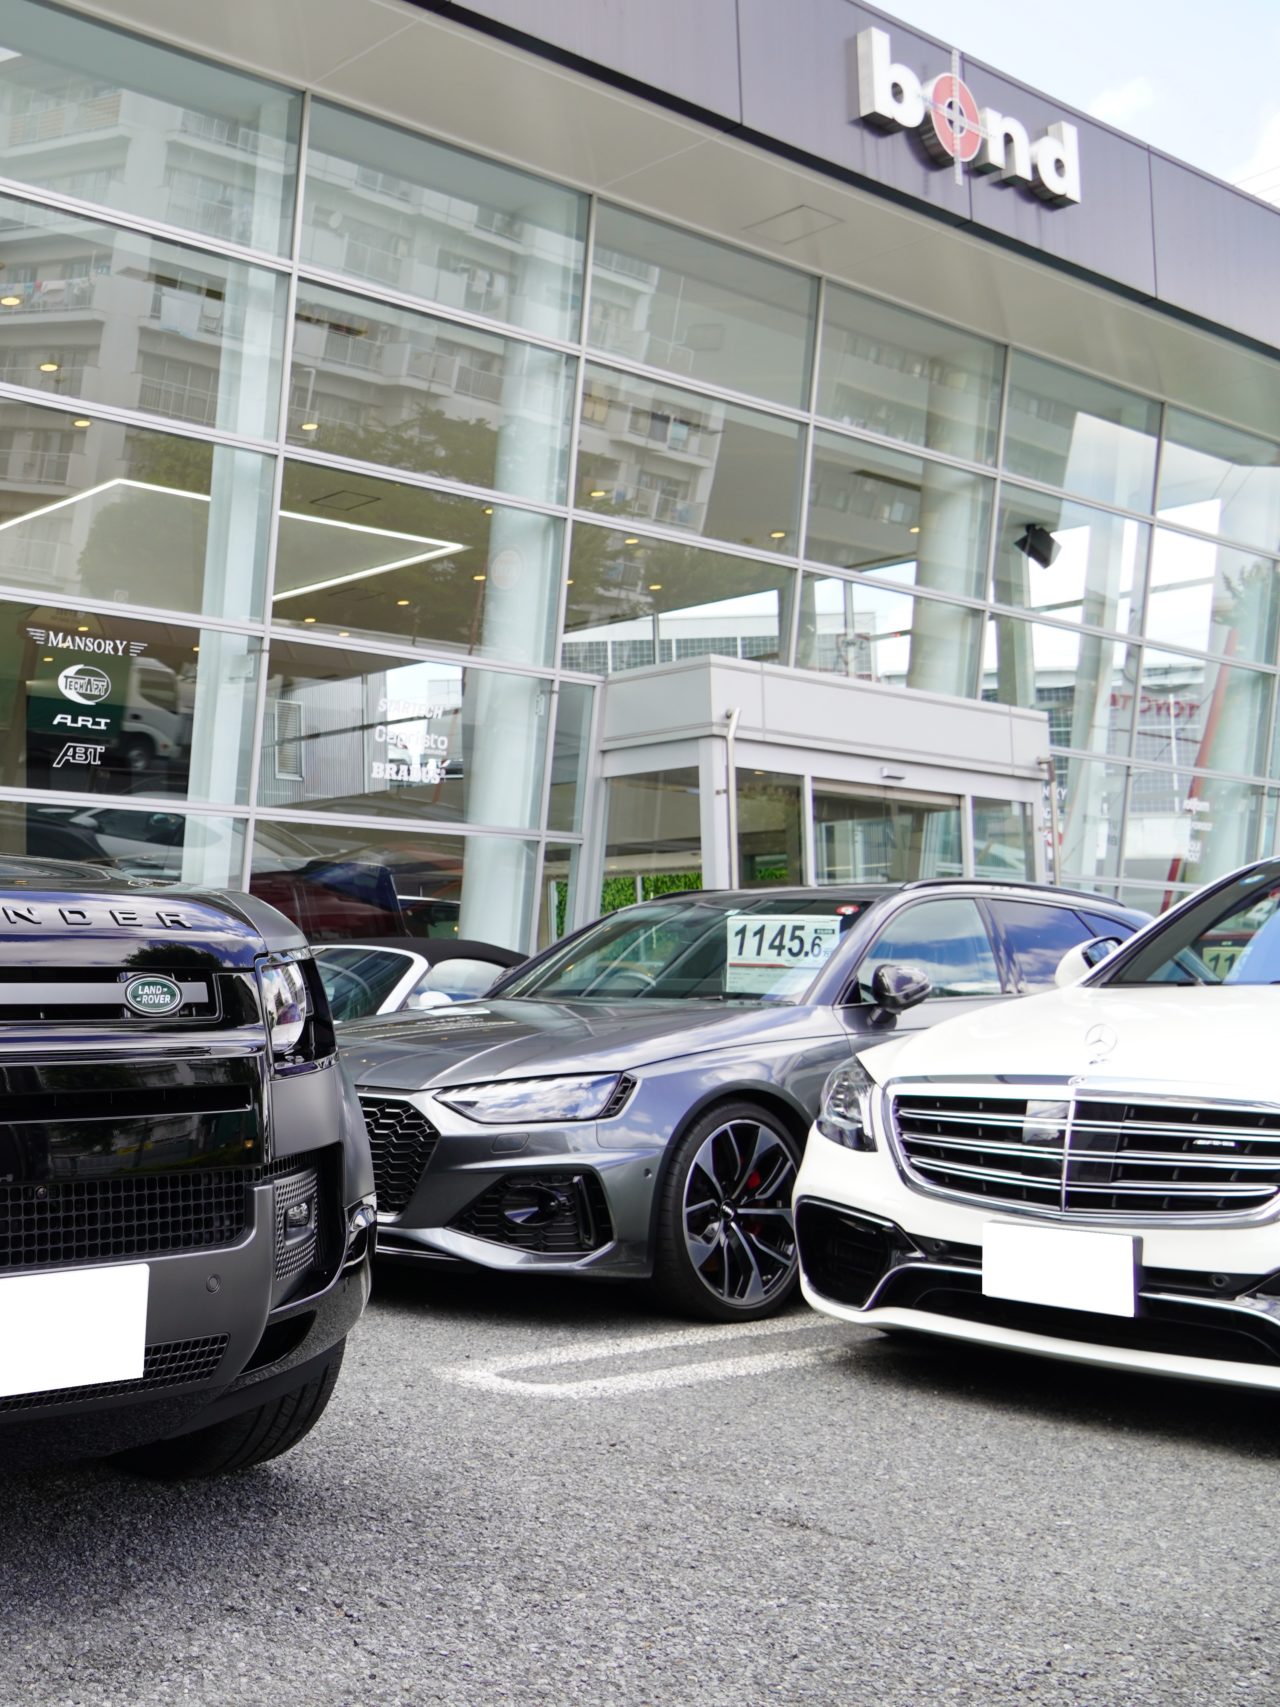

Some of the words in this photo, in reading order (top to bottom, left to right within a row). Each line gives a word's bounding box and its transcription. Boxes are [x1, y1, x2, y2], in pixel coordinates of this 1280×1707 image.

[857, 27, 1081, 209] bond
[47, 631, 128, 656] MANSORY
[53, 742, 105, 768] ABT
[371, 762, 441, 784] BRABUS
[138, 985, 163, 994] LAND
[141, 995, 171, 1004] ROVER
